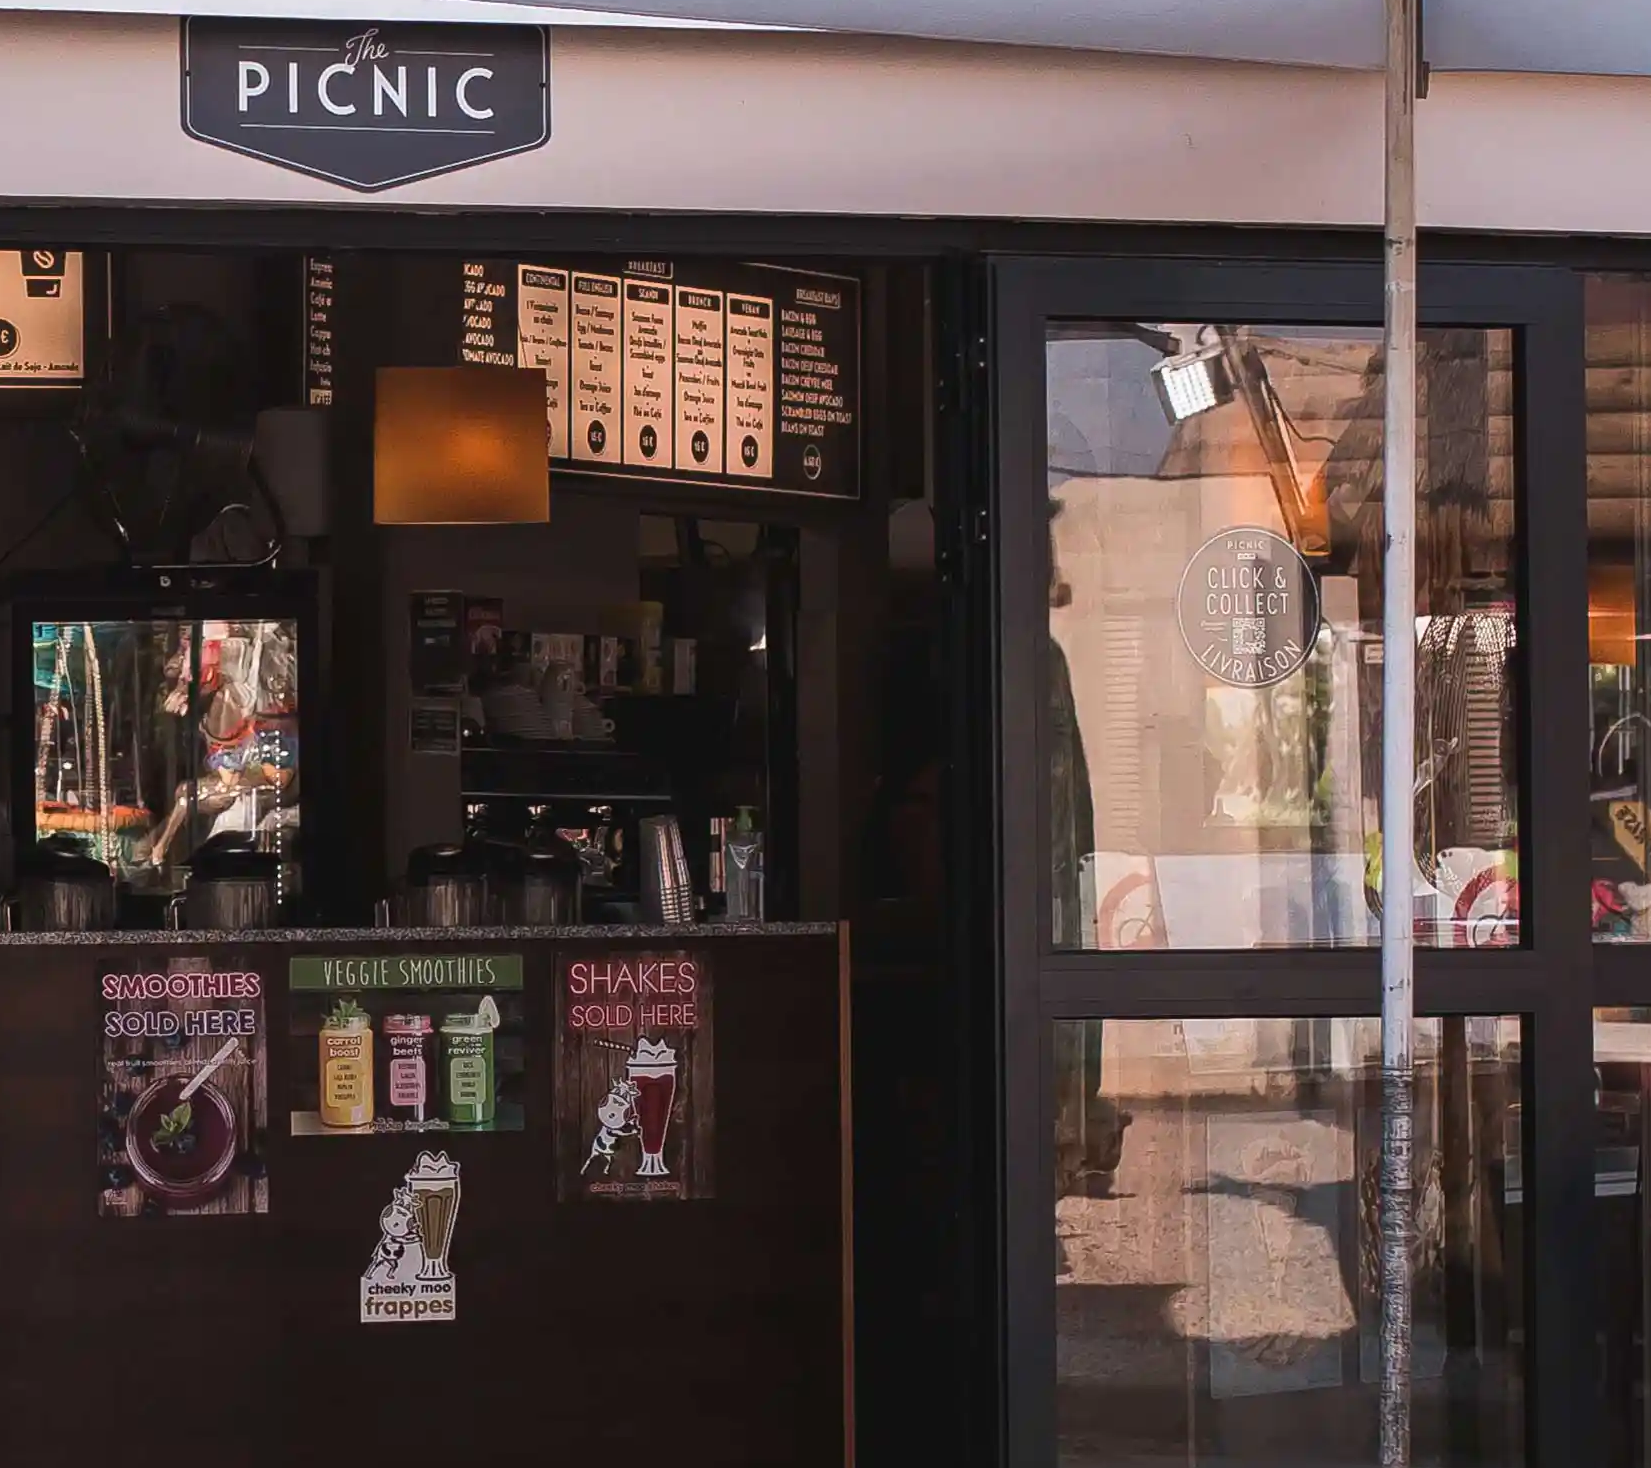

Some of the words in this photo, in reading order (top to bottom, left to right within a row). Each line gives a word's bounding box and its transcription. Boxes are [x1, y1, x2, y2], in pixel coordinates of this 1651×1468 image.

[344, 28, 389, 66] The
[238, 61, 495, 120] PICNIC
[1227, 540, 1265, 550] PICNIC
[1207, 567, 1264, 589] CLICK
[1275, 567, 1287, 589] &
[1206, 593, 1289, 616] COLLECT
[1200, 639, 1302, 682] LIVRAISON
[323, 959, 389, 986] VEGGIE
[399, 957, 496, 986] SMOOTHIES
[570, 962, 695, 994] SHAKES
[102, 973, 261, 1000] SMOOTHIES
[105, 1011, 179, 1037] SOLD
[185, 1009, 255, 1036] HERE
[572, 1004, 633, 1027] SOLD
[641, 1004, 694, 1026] HERE
[327, 1036, 361, 1046] carrot
[329, 1047, 360, 1057] boost
[390, 1036, 424, 1047] ginger
[448, 1046, 486, 1055] reviver
[452, 1036, 482, 1046] green
[368, 1282, 416, 1297] cheeky
[421, 1283, 451, 1294] moo
[365, 1297, 453, 1319] frappes
